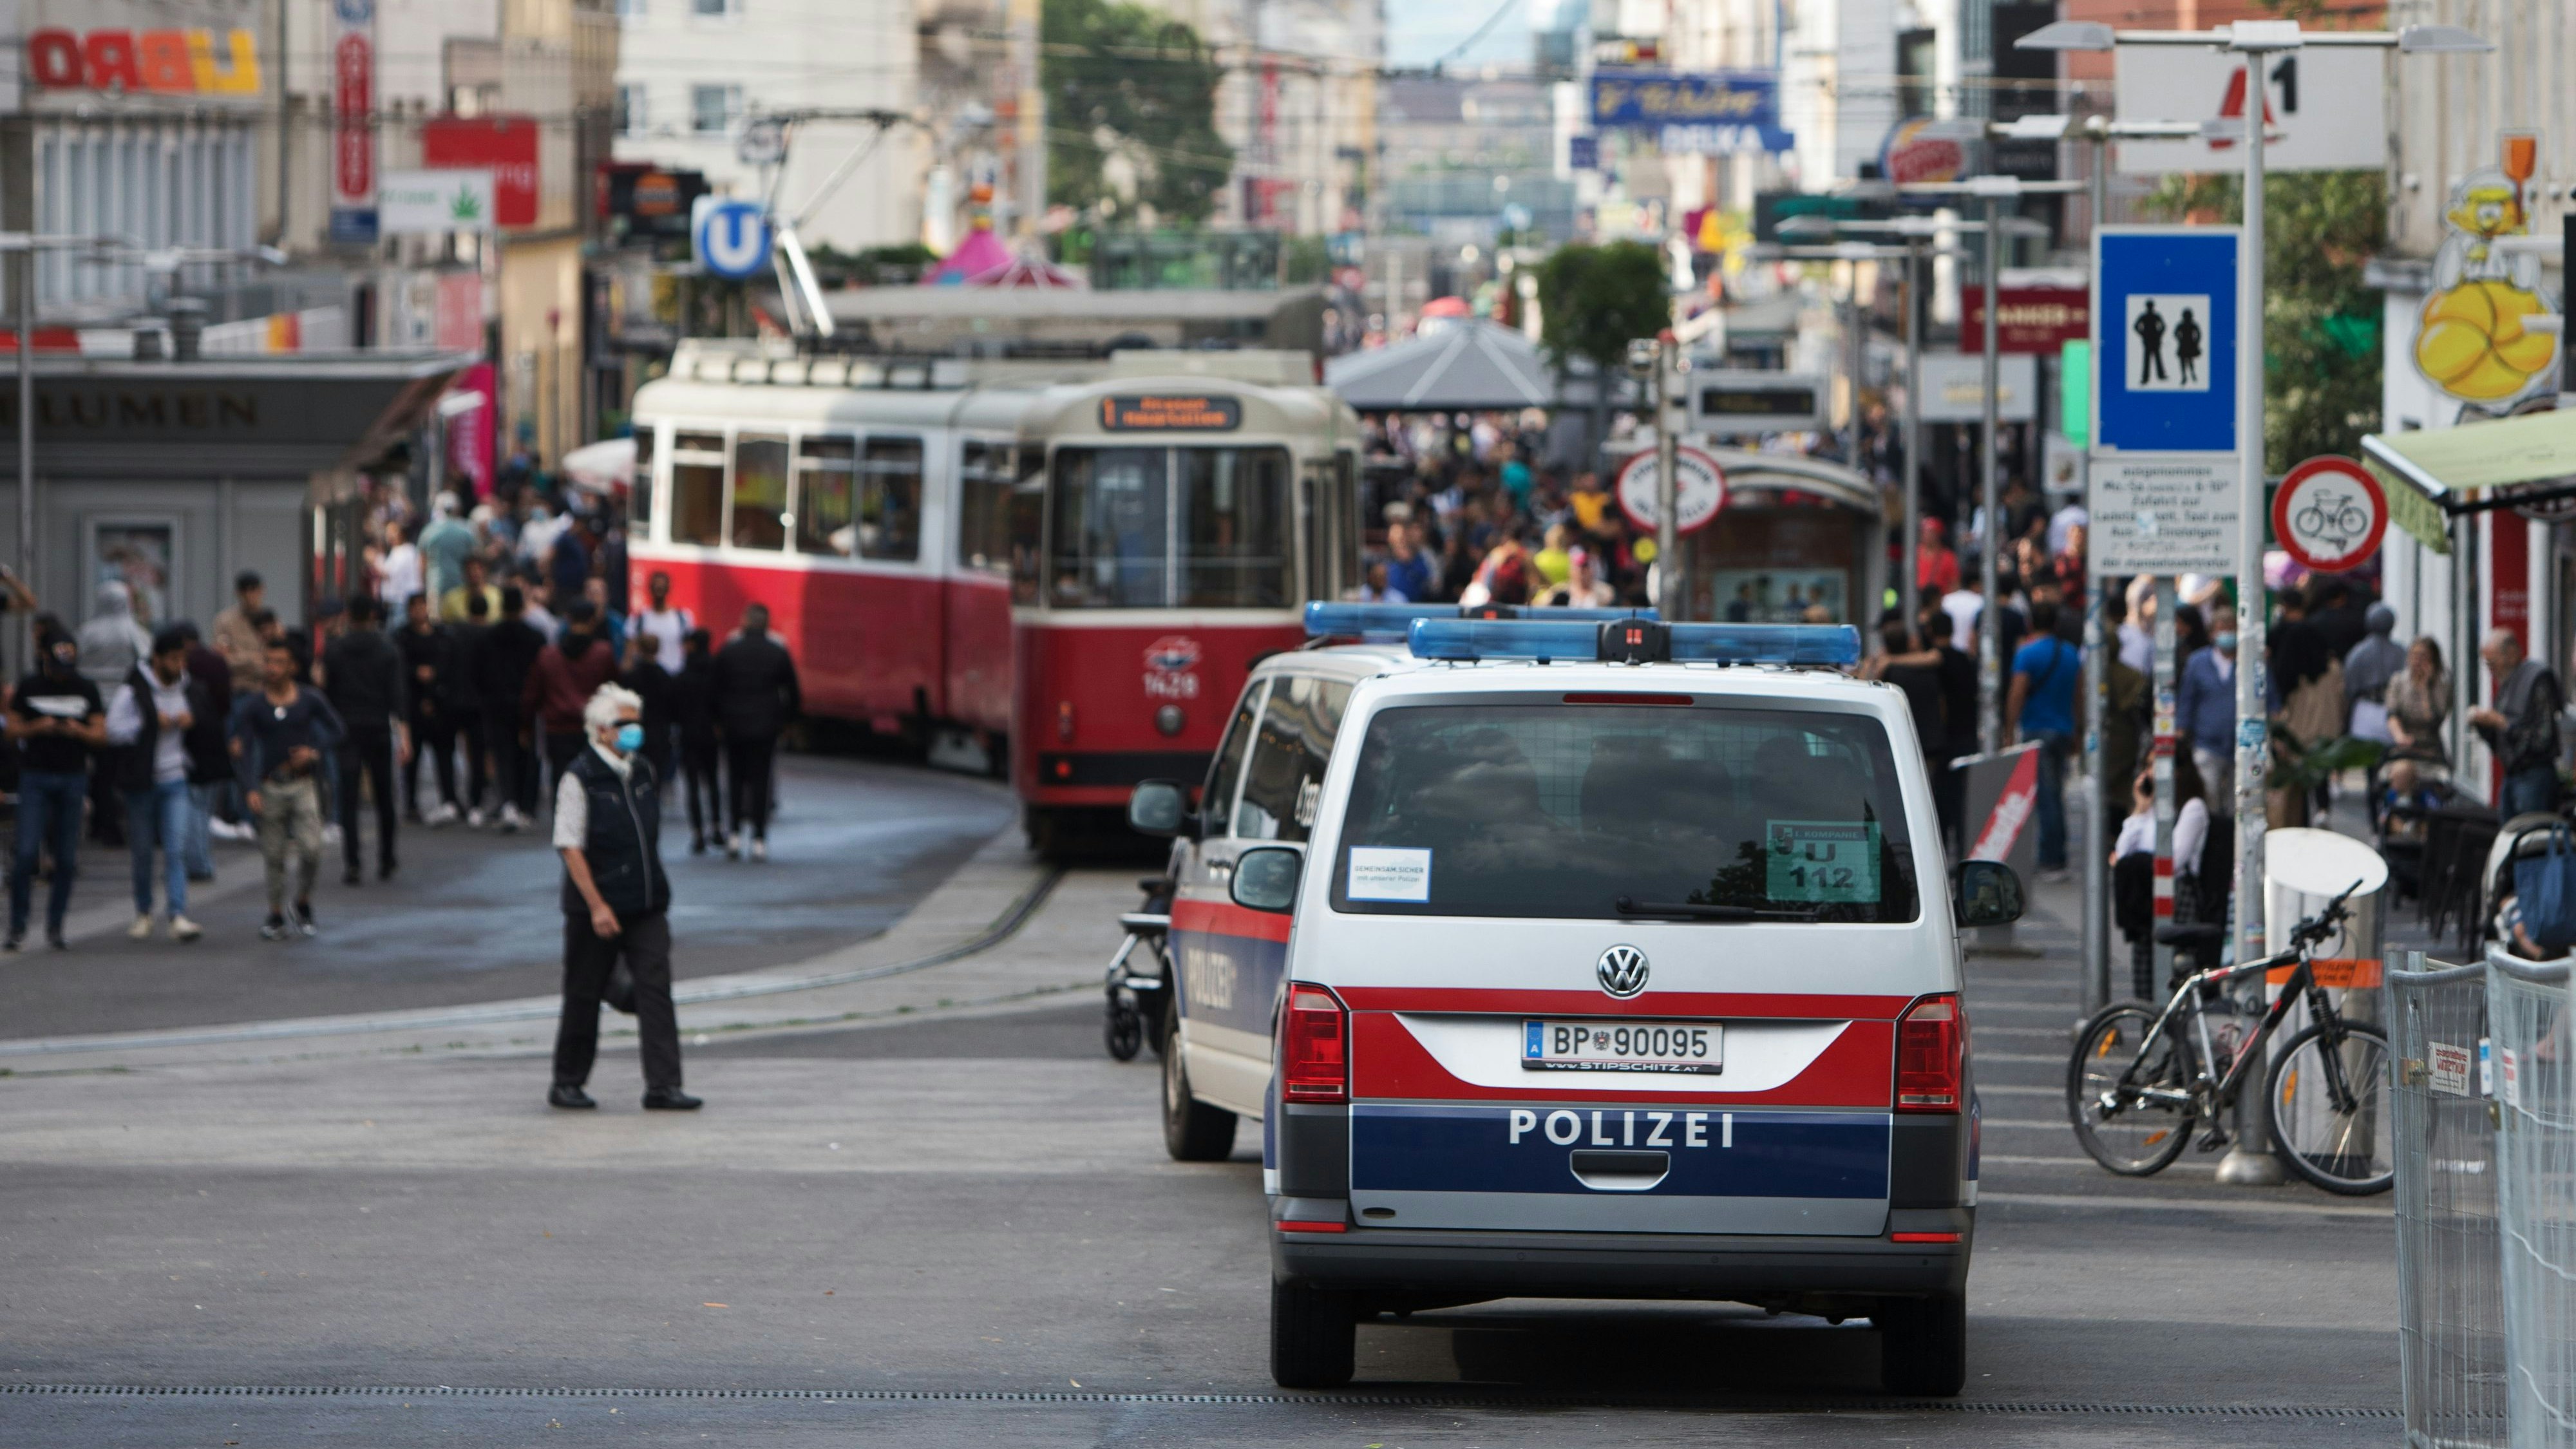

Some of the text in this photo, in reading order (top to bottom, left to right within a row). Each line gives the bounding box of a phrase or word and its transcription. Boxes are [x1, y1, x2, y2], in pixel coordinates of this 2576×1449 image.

[710, 213, 765, 271] U
[2123, 466, 2212, 477] ausgenommen
[1805, 843, 1835, 862] U
[1790, 866, 1855, 888] 112
[1188, 947, 1233, 1009] POLIZEI
[1530, 1044, 1539, 1053] A
[1554, 1027, 1708, 1057] BP 90095
[1510, 1110, 1732, 1148] POLIZEI
